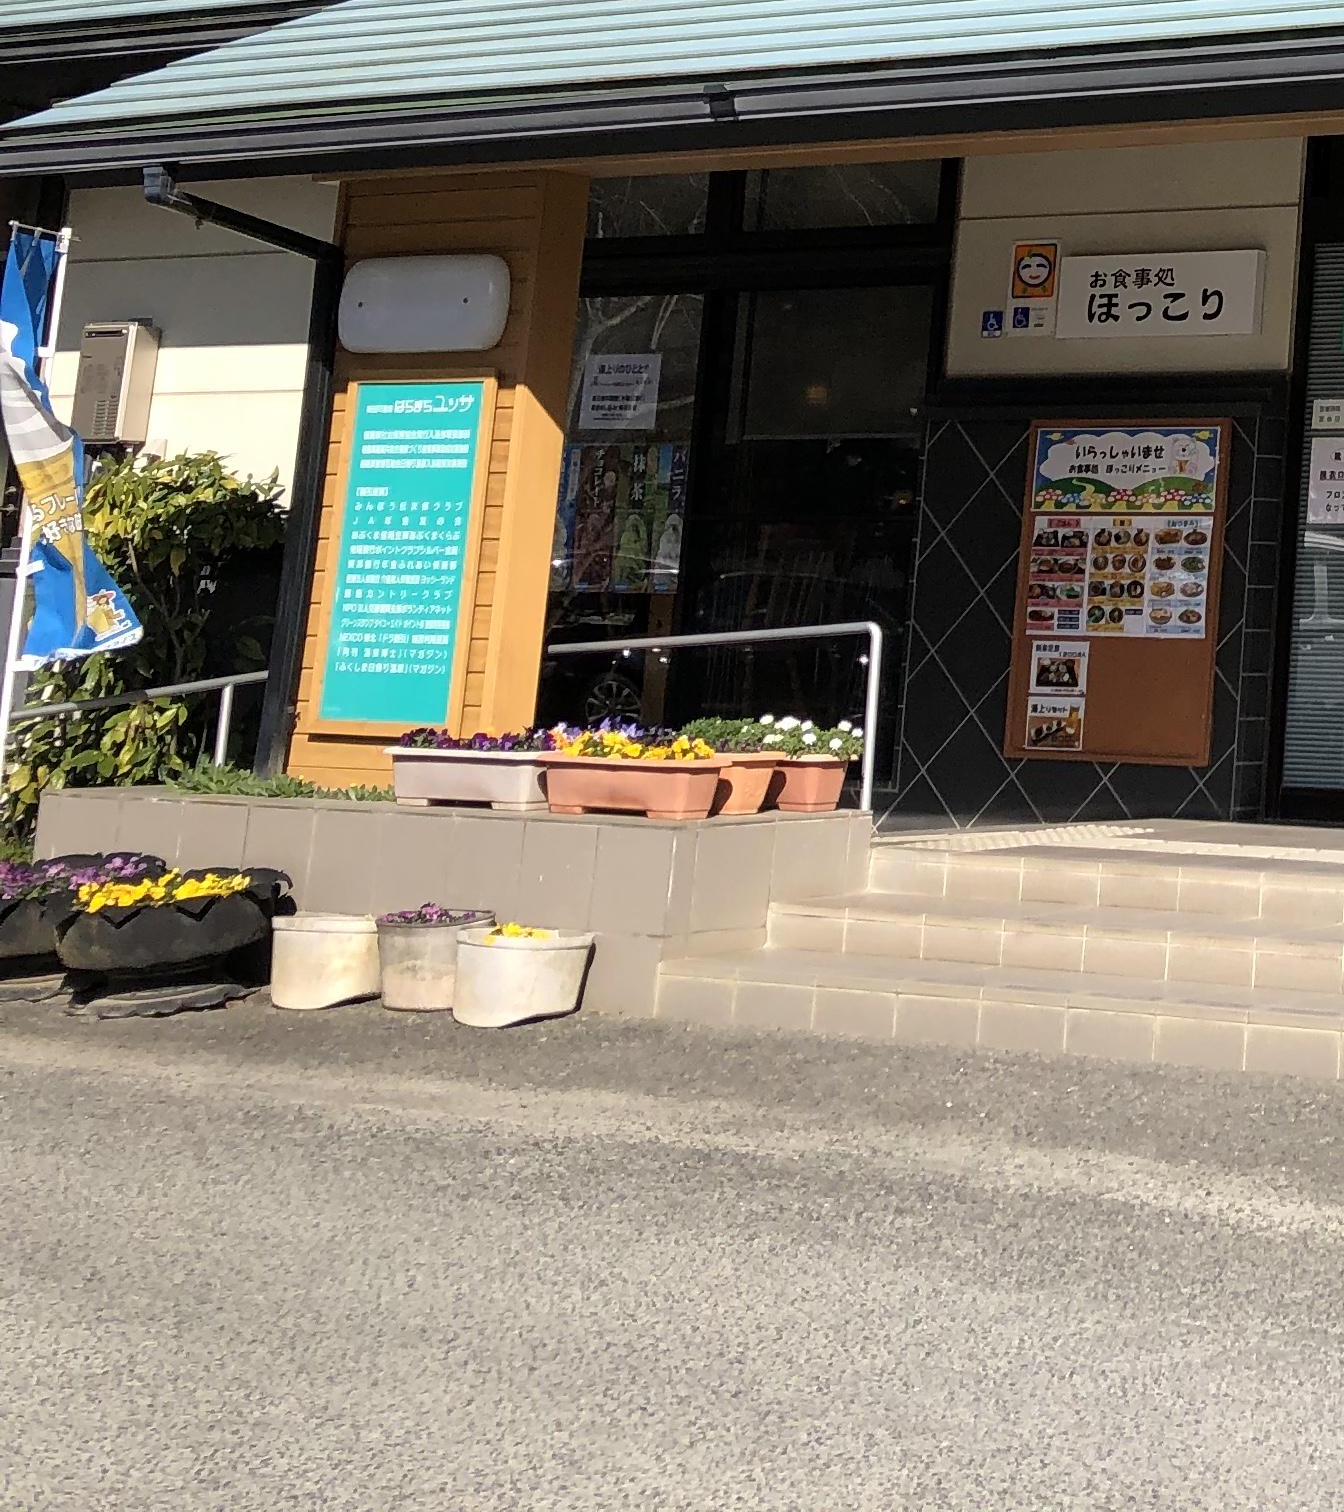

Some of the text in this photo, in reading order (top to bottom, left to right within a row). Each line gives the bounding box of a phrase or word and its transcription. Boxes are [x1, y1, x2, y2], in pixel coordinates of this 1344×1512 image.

[1089, 267, 1176, 289] お食事処
[1087, 287, 1225, 323] ほっこり
[1075, 445, 1166, 460] いらっしゃいませ
